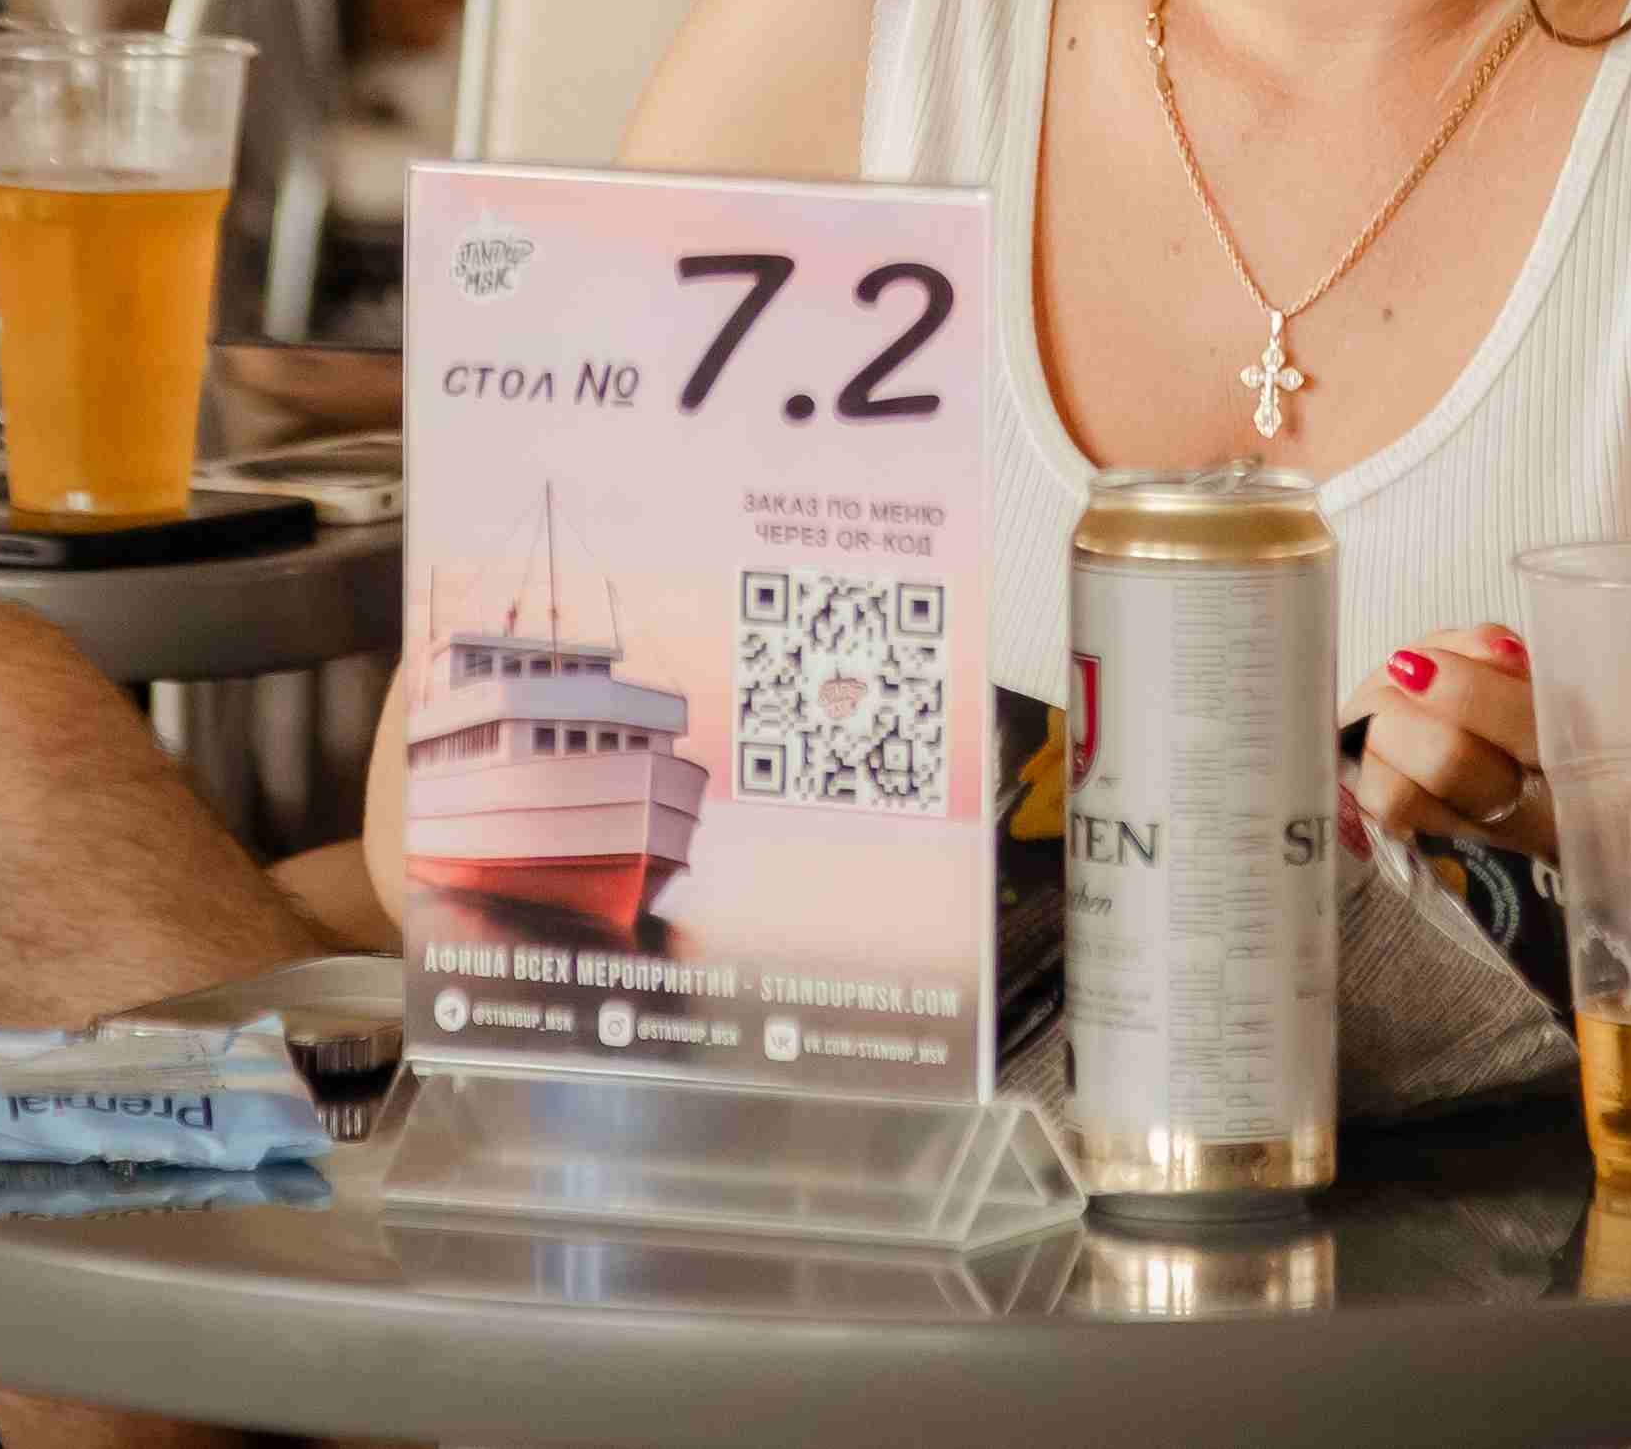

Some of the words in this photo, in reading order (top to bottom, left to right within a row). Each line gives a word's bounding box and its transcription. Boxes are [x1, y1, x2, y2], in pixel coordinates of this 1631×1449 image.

[677, 253, 955, 422] 7.2
[743, 492, 819, 518] ЗАКАЗ
[826, 498, 862, 521] ПО
[870, 501, 946, 527] МЕНЮ
[754, 523, 828, 548] ЧЕРЕЗ
[836, 530, 933, 558] QR-КОД
[423, 942, 507, 978] АФИША
[512, 946, 571, 984] ВСЕХ
[575, 953, 737, 999] МЕРОПРИЯТИЙ
[760, 973, 961, 1018] STANDUPMSK.COM
[471, 1004, 575, 1033] @STANDUP_MSK
[6, 1093, 213, 1131] Premial
